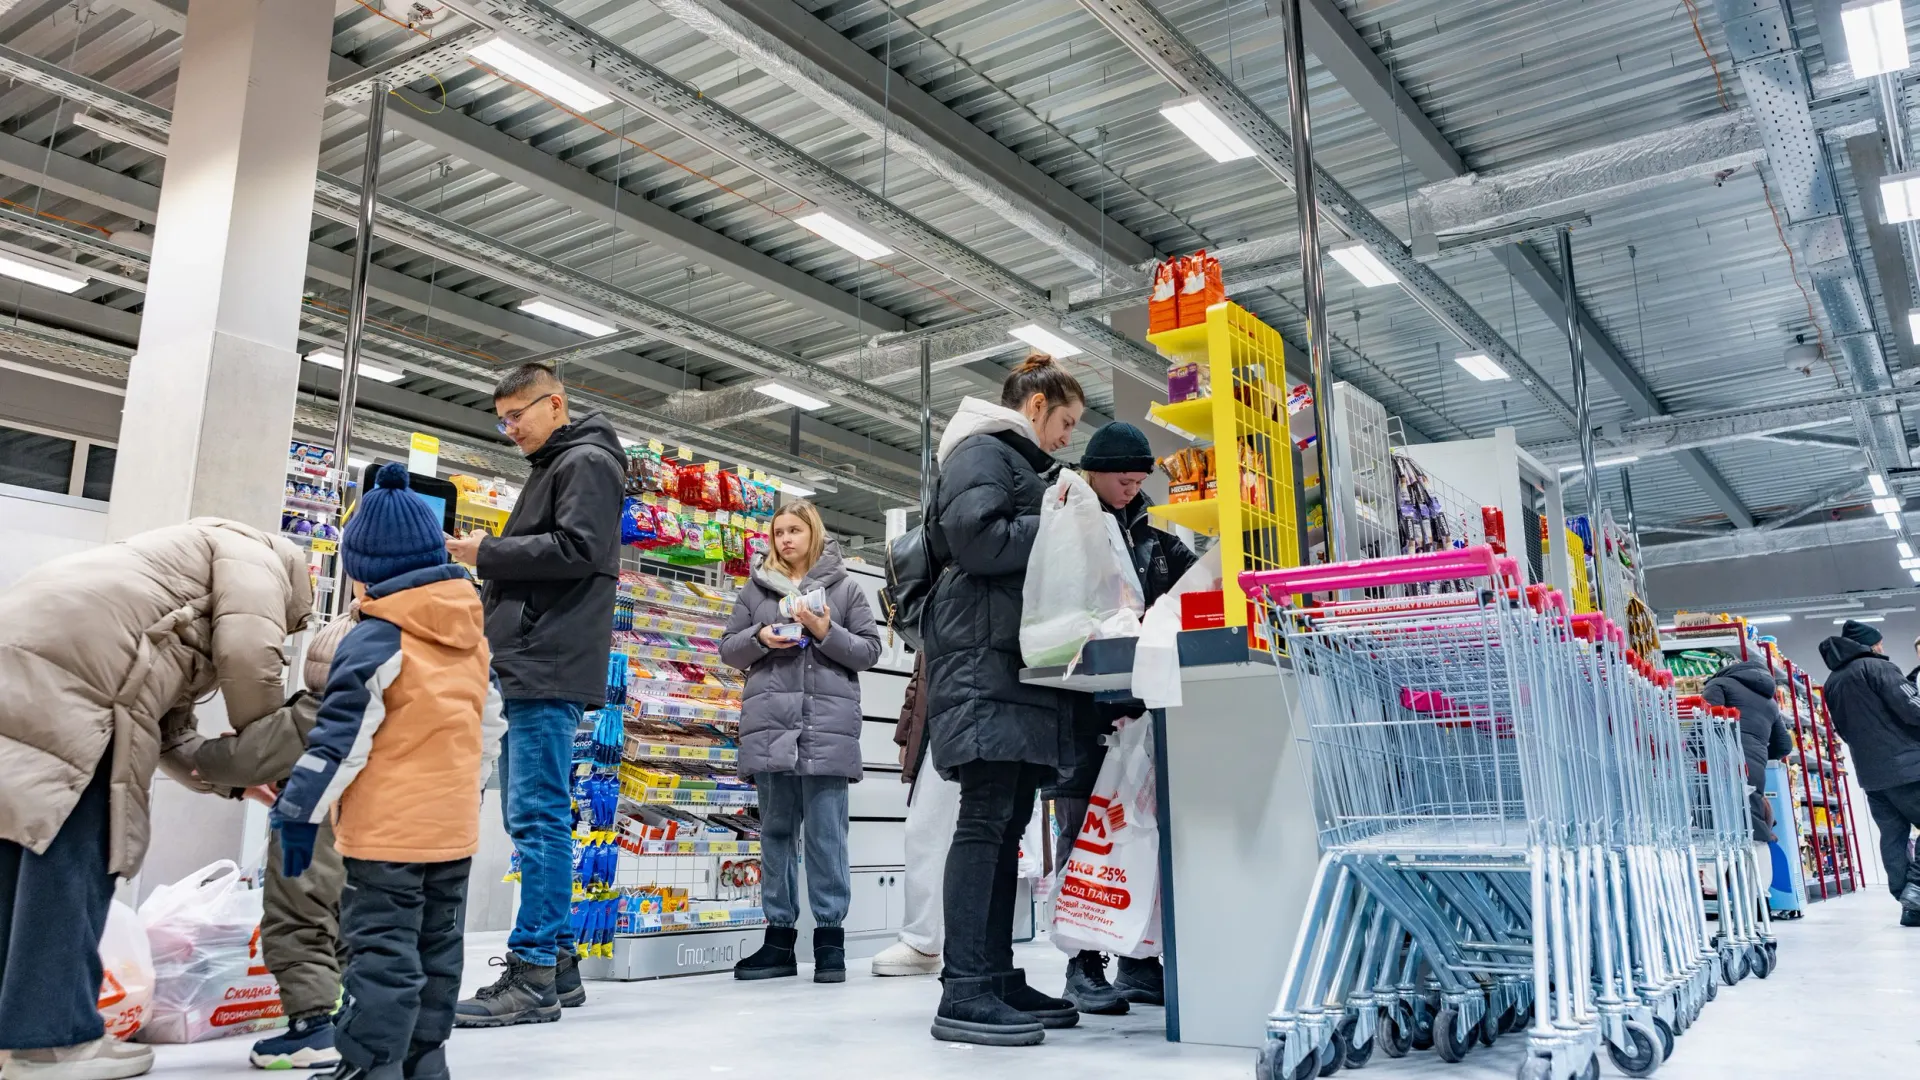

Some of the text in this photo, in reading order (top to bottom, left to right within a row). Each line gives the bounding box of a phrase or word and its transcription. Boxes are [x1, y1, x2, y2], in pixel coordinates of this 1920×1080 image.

[1337, 597, 1477, 616] ЗАКАЖИТЕ ДОСТАВКУ В ПРИЛОЖЕНИИ
[1097, 865, 1127, 883] 25%
[1087, 888, 1124, 905] ПАКЕТ
[1079, 903, 1106, 915] заказ
[1083, 912, 1115, 927] Магнит
[676, 943, 734, 967] Сторона
[224, 985, 273, 1000] Скидка
